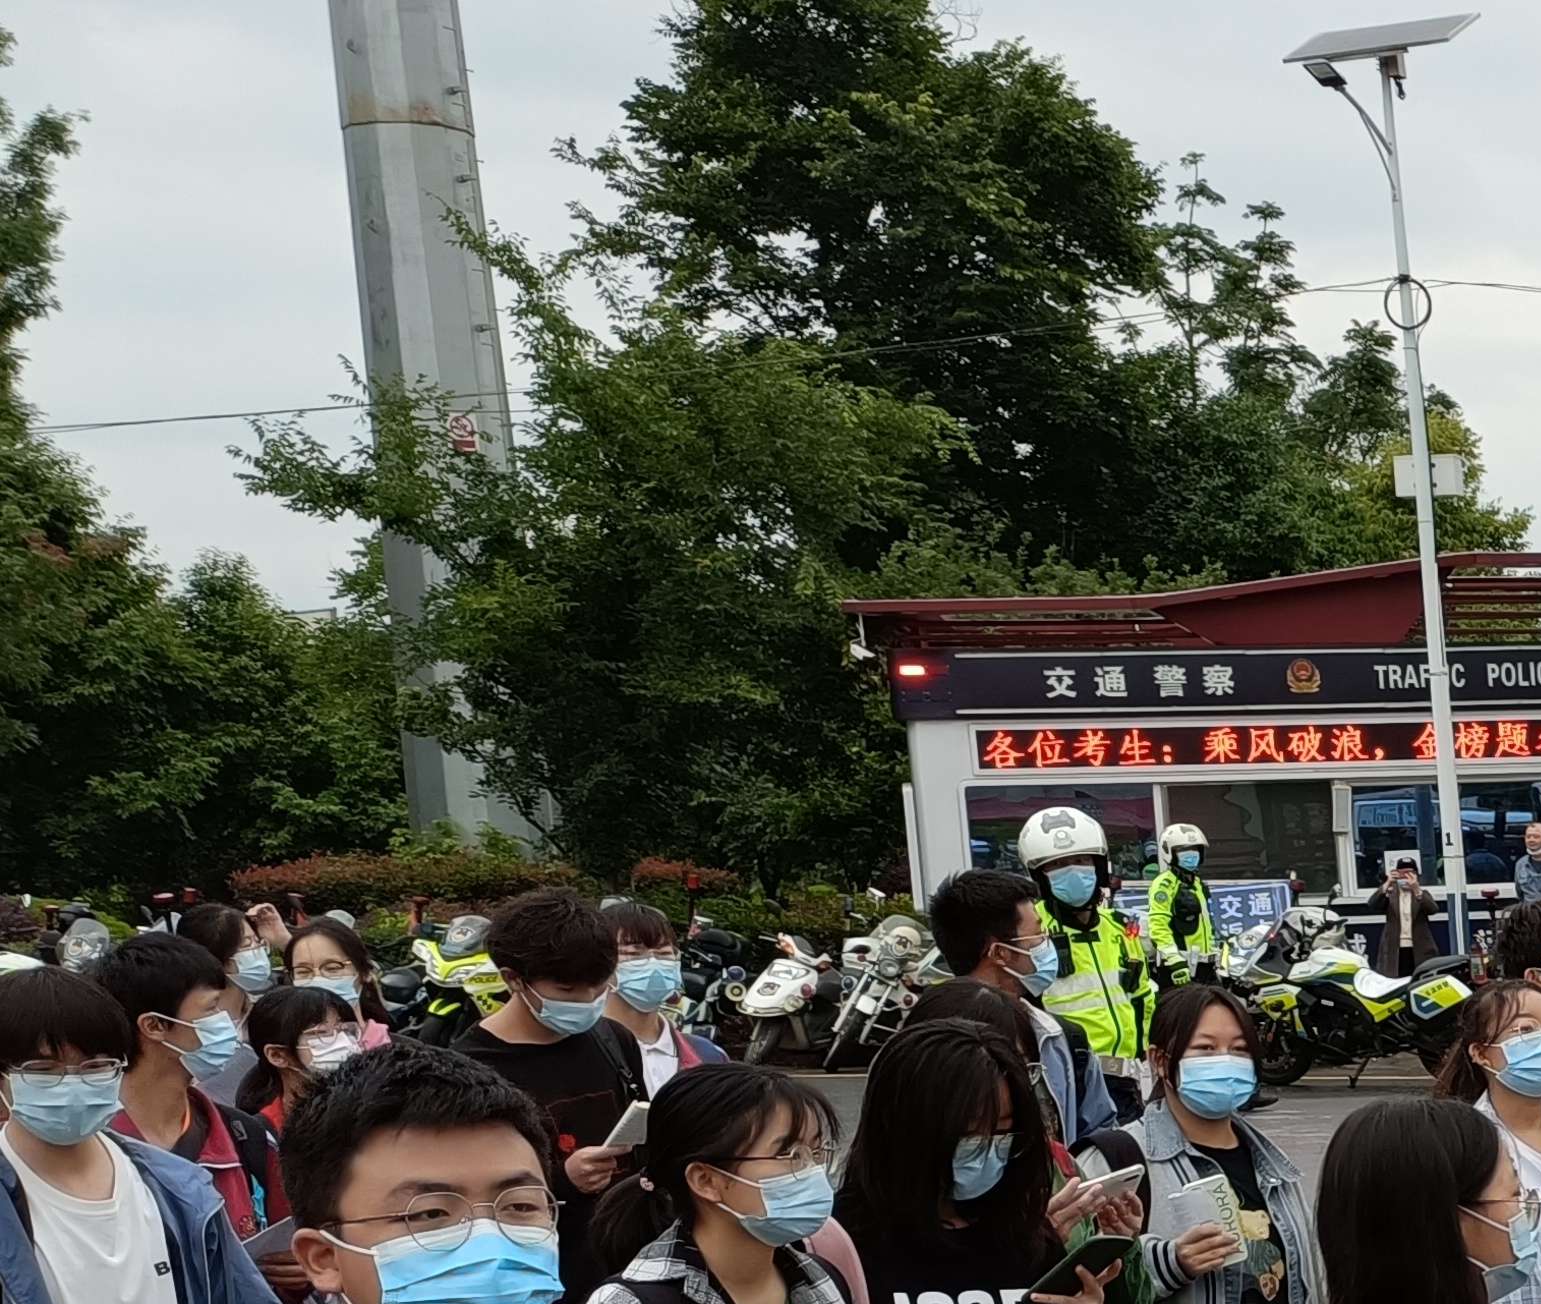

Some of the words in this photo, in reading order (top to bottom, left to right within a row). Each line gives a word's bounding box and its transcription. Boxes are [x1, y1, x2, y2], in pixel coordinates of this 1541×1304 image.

[1043, 664, 1235, 698] 交通警察
[1374, 662, 1466, 690] TRAFC
